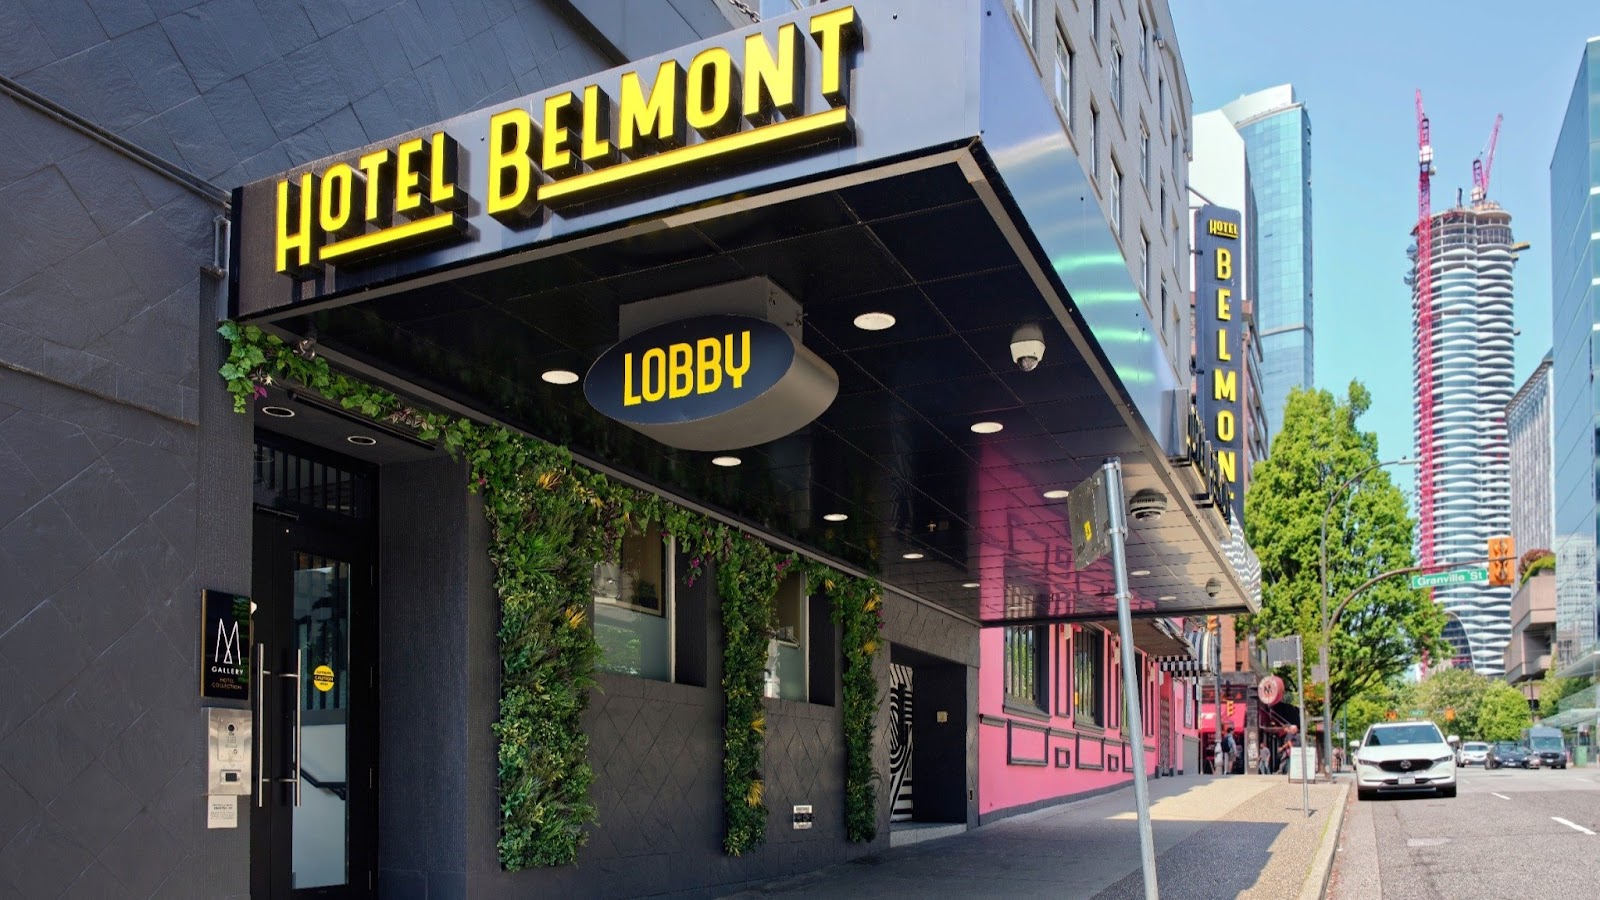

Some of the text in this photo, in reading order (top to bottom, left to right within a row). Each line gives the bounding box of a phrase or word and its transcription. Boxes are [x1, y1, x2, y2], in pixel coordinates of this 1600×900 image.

[275, 5, 854, 273] HOTEL BELMONT
[1209, 219, 1238, 235] HOTEL
[623, 330, 751, 407] LOBBY
[1214, 247, 1237, 499] BELMON
[1417, 571, 1483, 586] Granville St
[211, 666, 244, 676] GALLERY
